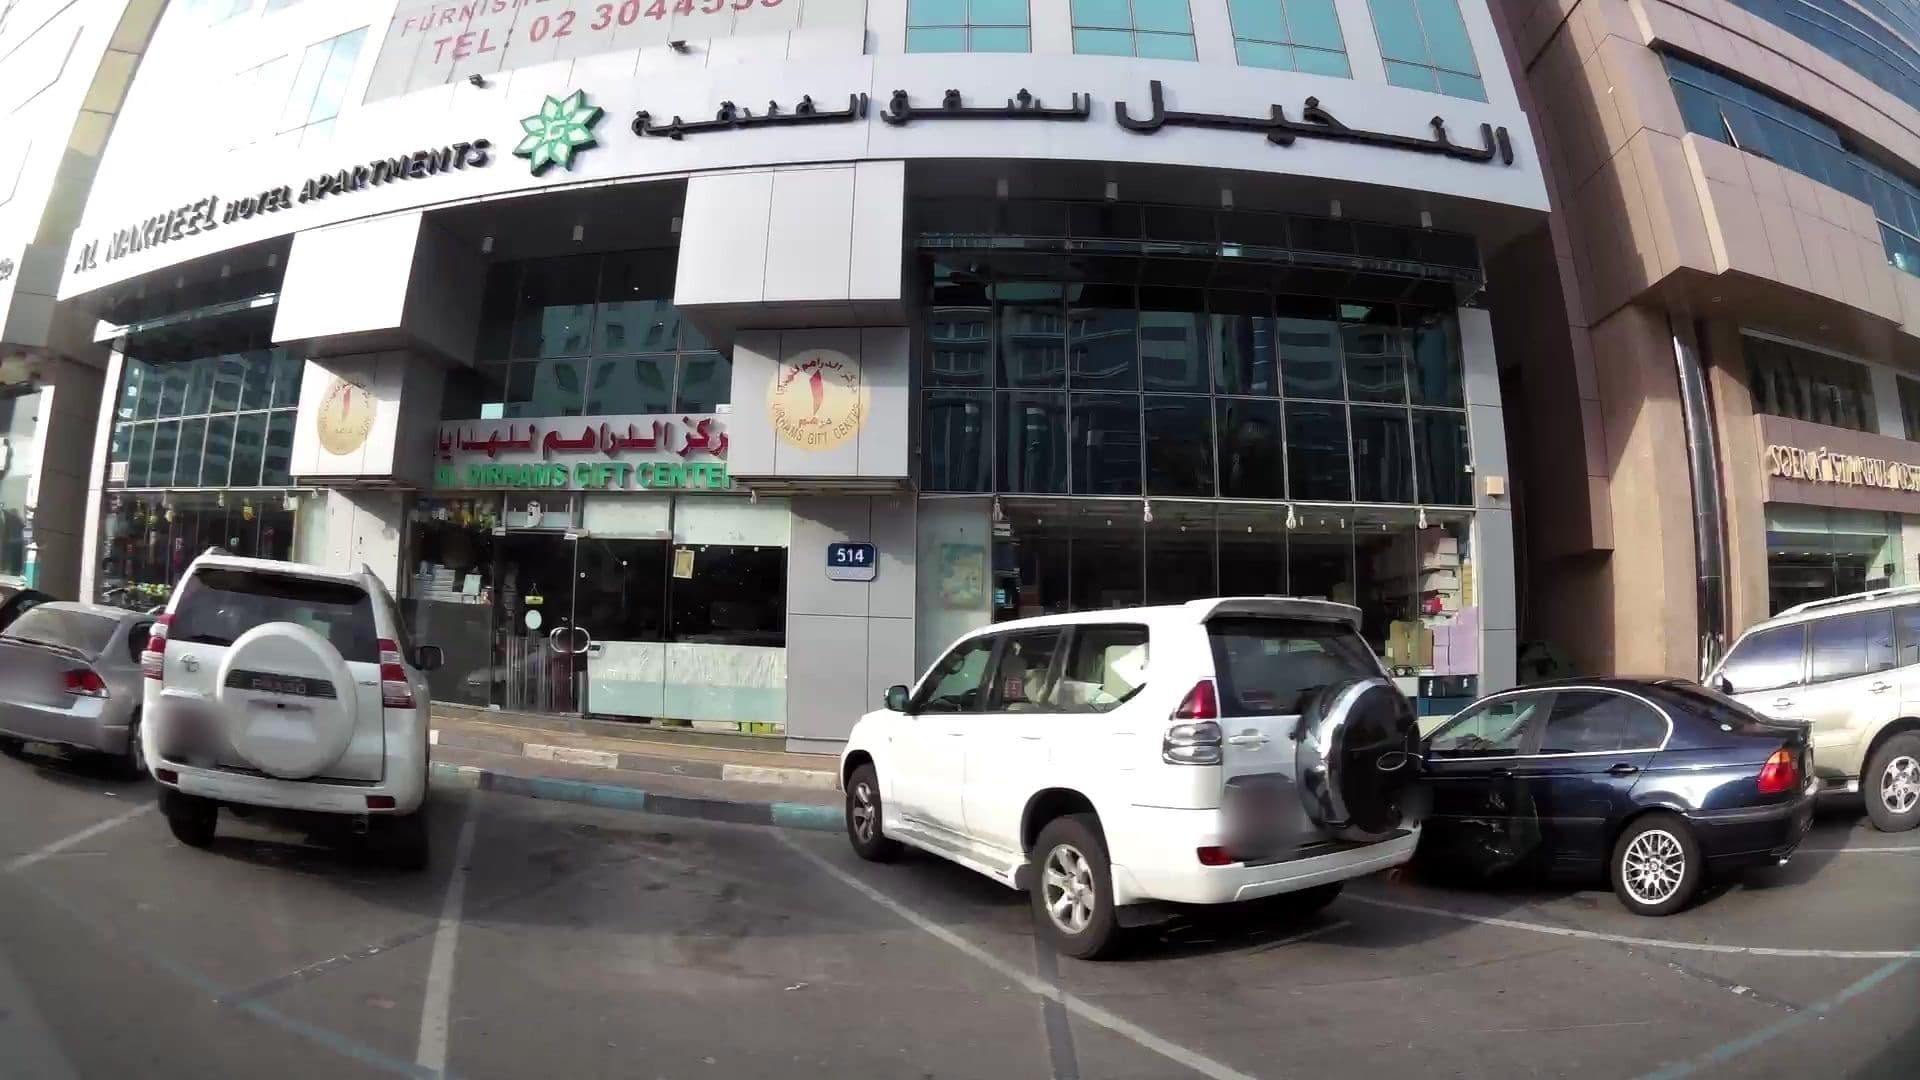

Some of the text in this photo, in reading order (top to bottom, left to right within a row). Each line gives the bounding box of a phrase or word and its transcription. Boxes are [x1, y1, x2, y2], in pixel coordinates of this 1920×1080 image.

[529, 9, 576, 43] 02
[631, 79, 1515, 166] النخيل للشقق الفندقية
[74, 239, 99, 275] AL
[105, 195, 220, 263] NAKHEEL
[222, 184, 295, 226] HOTEL
[297, 137, 495, 205] APARTMENTS
[543, 419, 672, 461] الدراهم
[573, 462, 634, 488] GIFT
[836, 547, 865, 563] 514
